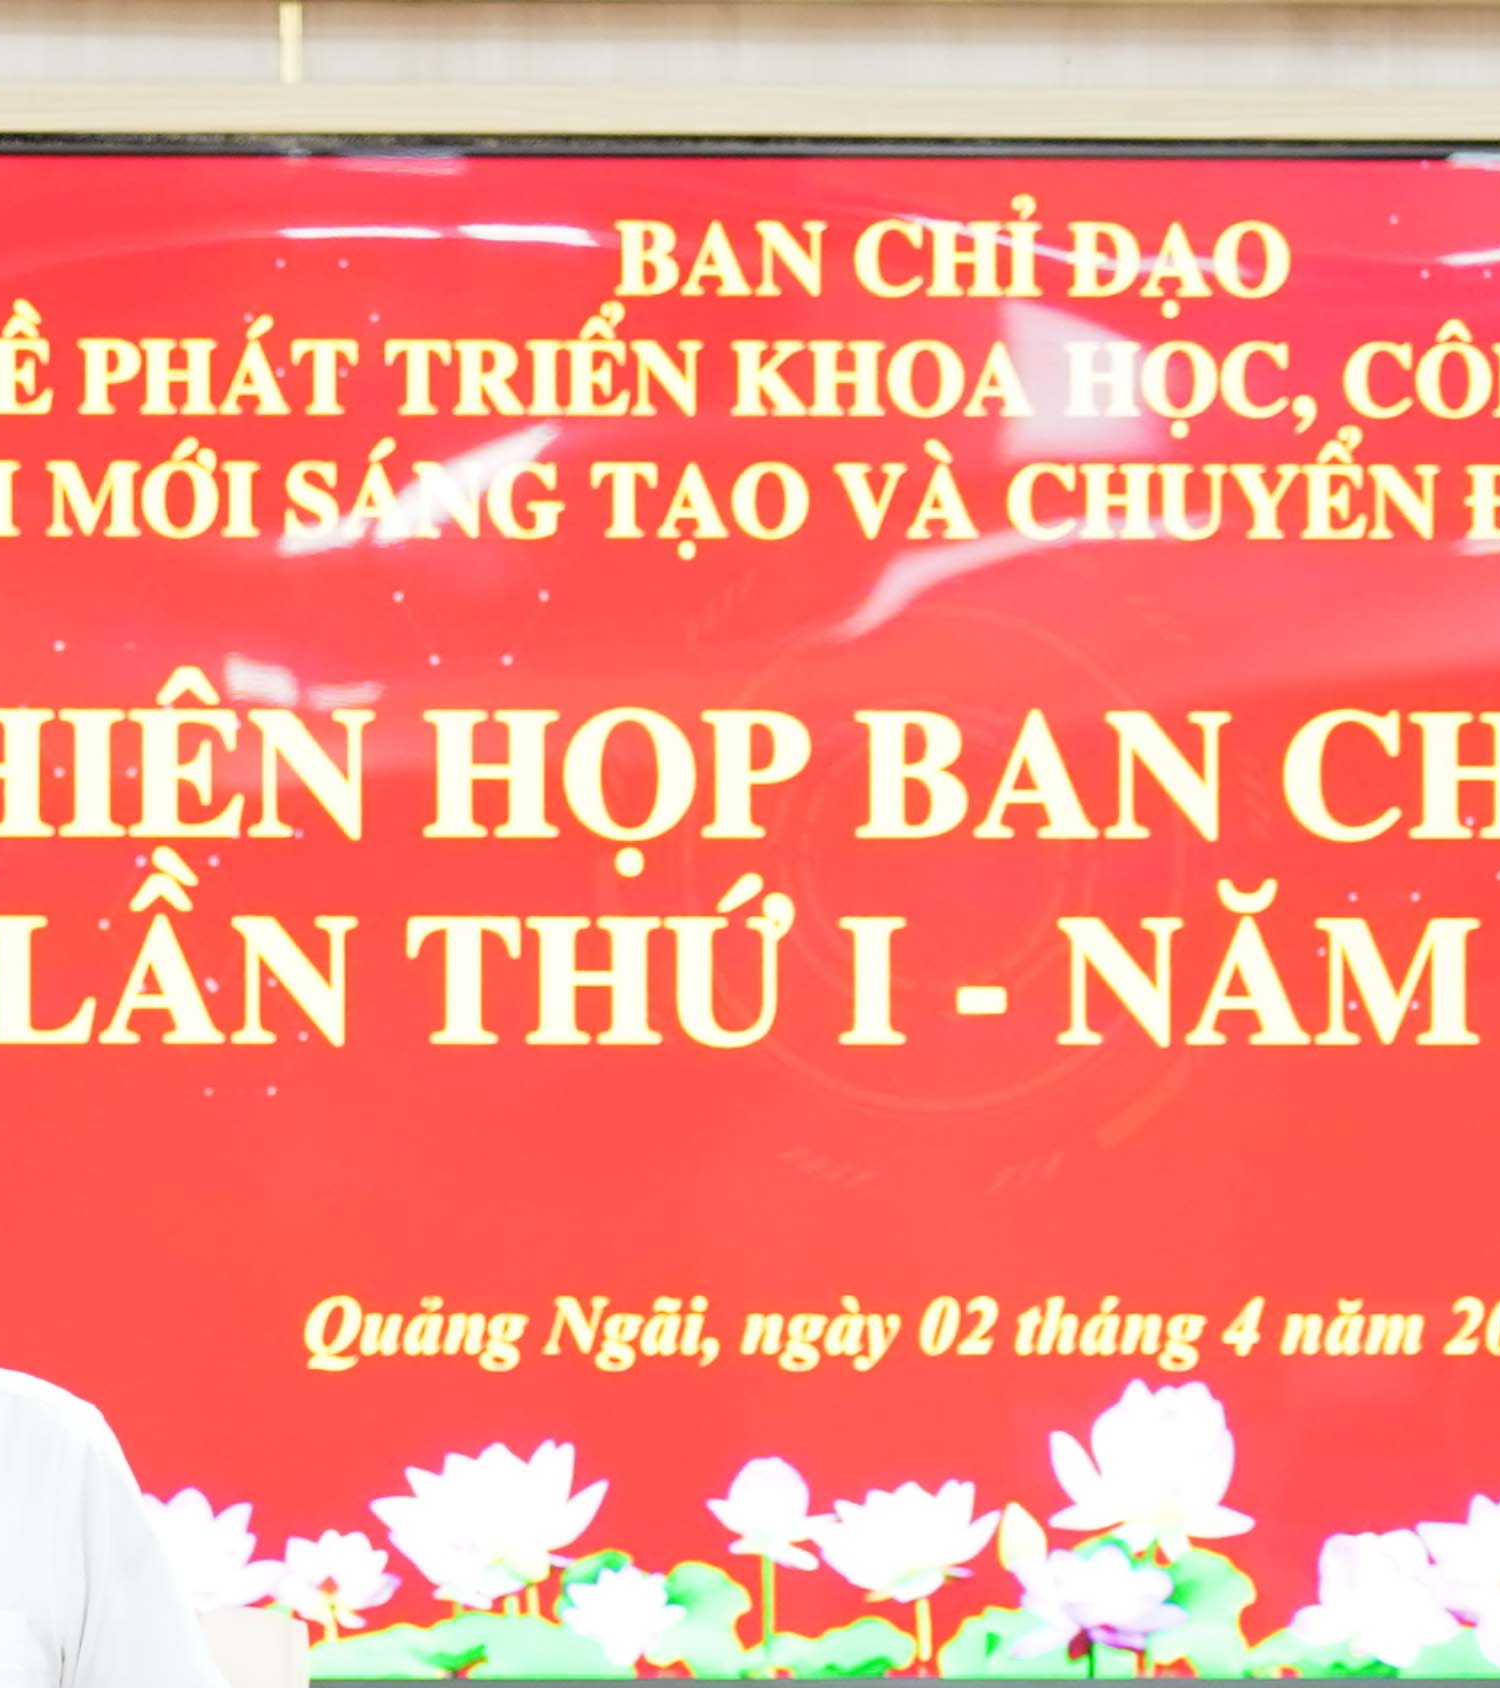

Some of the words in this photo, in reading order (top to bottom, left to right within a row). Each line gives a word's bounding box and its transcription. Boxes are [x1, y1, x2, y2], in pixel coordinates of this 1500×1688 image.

[614, 220, 826, 297] BAN
[855, 195, 1037, 298] CHỈ
[1067, 220, 1290, 318] ĐẠO
[79, 316, 359, 415] PHÁT
[385, 302, 702, 416] TRIỂN
[733, 340, 1033, 417] KHOA
[1064, 341, 1317, 439] HỌC,
[47, 437, 259, 538] MỚI
[284, 437, 565, 540] SÁNG
[590, 463, 809, 559] TẠO
[835, 439, 979, 540] VÀ
[1006, 426, 1438, 540] CHUYỂN
[423, 707, 811, 877] HỌP
[854, 709, 1231, 841] BAN
[406, 873, 795, 1047] THỨ
[839, 916, 906, 1045] I
[1057, 879, 1480, 1047] NĂM
[304, 1295, 528, 1372] Quảng
[544, 1295, 720, 1372] Ngãi,
[740, 1295, 901, 1372] ngày
[919, 1295, 999, 1356] 02
[1014, 1295, 1206, 1372] tháng
[1222, 1296, 1264, 1356] 4
[1280, 1298, 1424, 1356] năm
